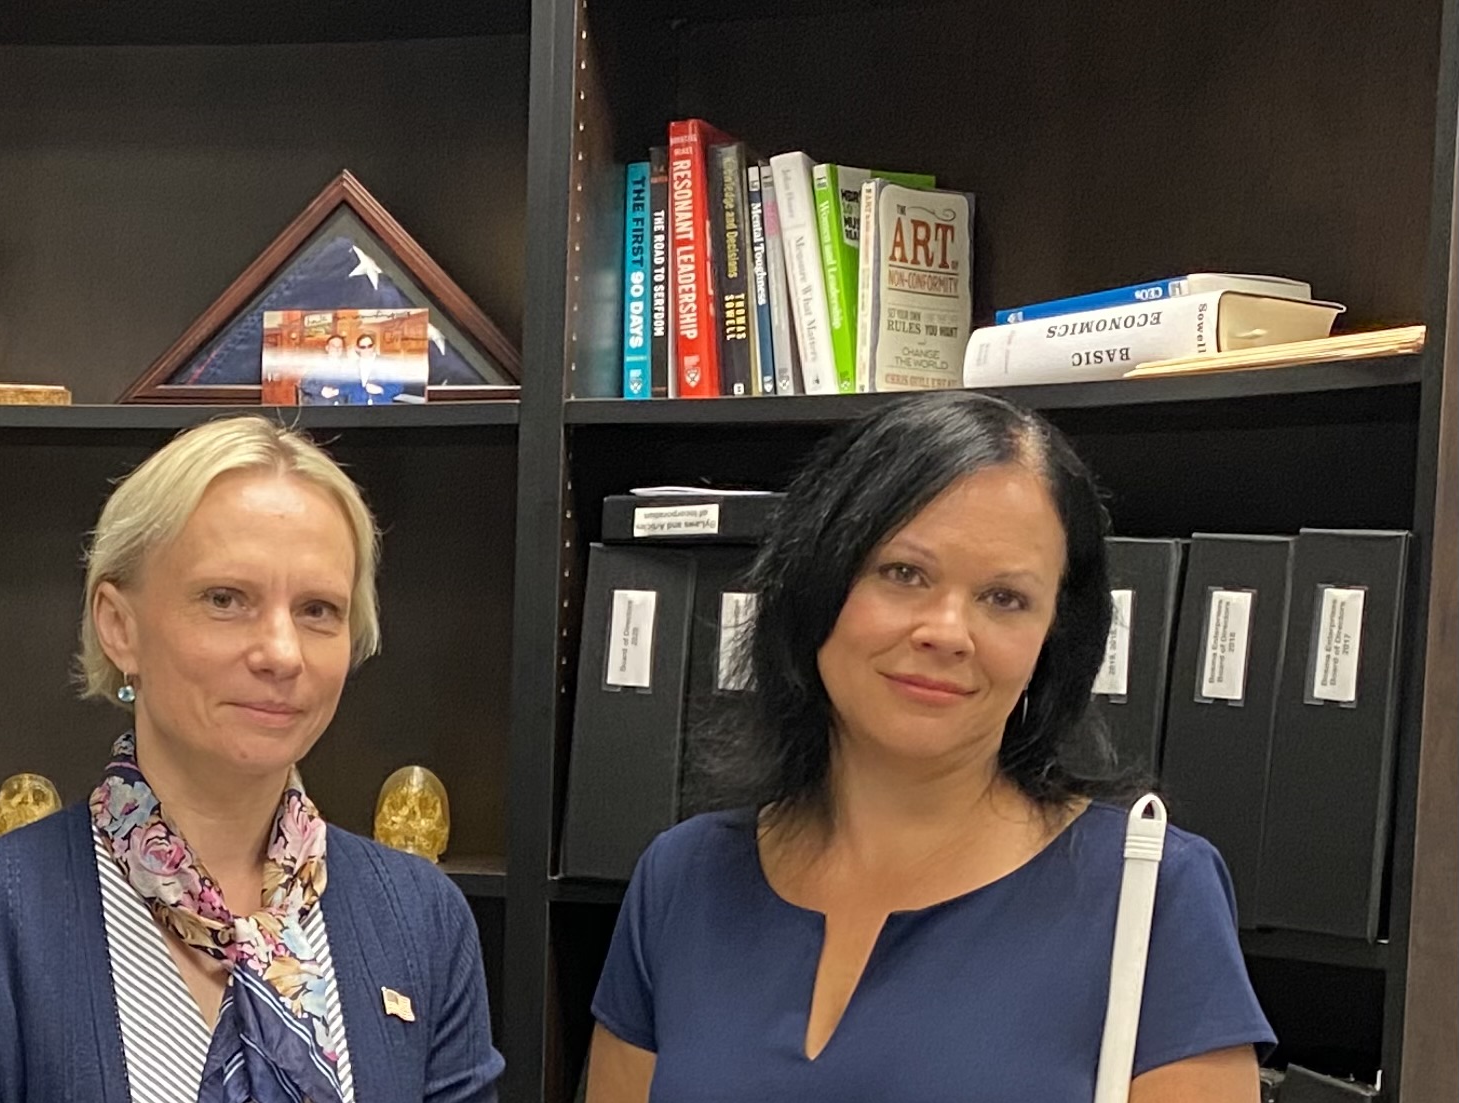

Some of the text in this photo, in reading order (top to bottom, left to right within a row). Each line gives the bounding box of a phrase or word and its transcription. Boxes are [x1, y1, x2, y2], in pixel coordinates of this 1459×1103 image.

[672, 160, 693, 240] RESONANT
[726, 212, 737, 229] and
[629, 176, 647, 348] THE FIRST 90 DAYS
[725, 231, 740, 278] Decisions
[750, 202, 767, 305] Mental Toughness
[819, 200, 843, 330] Women and Leadership
[889, 217, 955, 269] ART
[653, 210, 665, 337] THE ROAD TO SERFDOM
[676, 246, 698, 339] LEADERSHIP
[889, 269, 959, 294] NON-CONFORMITY
[1134, 286, 1163, 301] CEOs
[724, 295, 735, 341] SOWELL
[735, 293, 746, 340] THOMAS
[794, 236, 820, 363] Measure What Matters
[887, 319, 922, 335] RULES
[925, 325, 938, 337] YOU
[1046, 311, 1163, 339] ECONOMICS
[1196, 303, 1208, 354] Sowell
[894, 357, 949, 370] THE WORLD
[902, 347, 940, 359] CHANGE
[1071, 347, 1131, 367] BASIC
[1217, 601, 1230, 683] Board of Directors
[1329, 601, 1345, 686] Board of Directors
[1342, 633, 1351, 656] 2017
